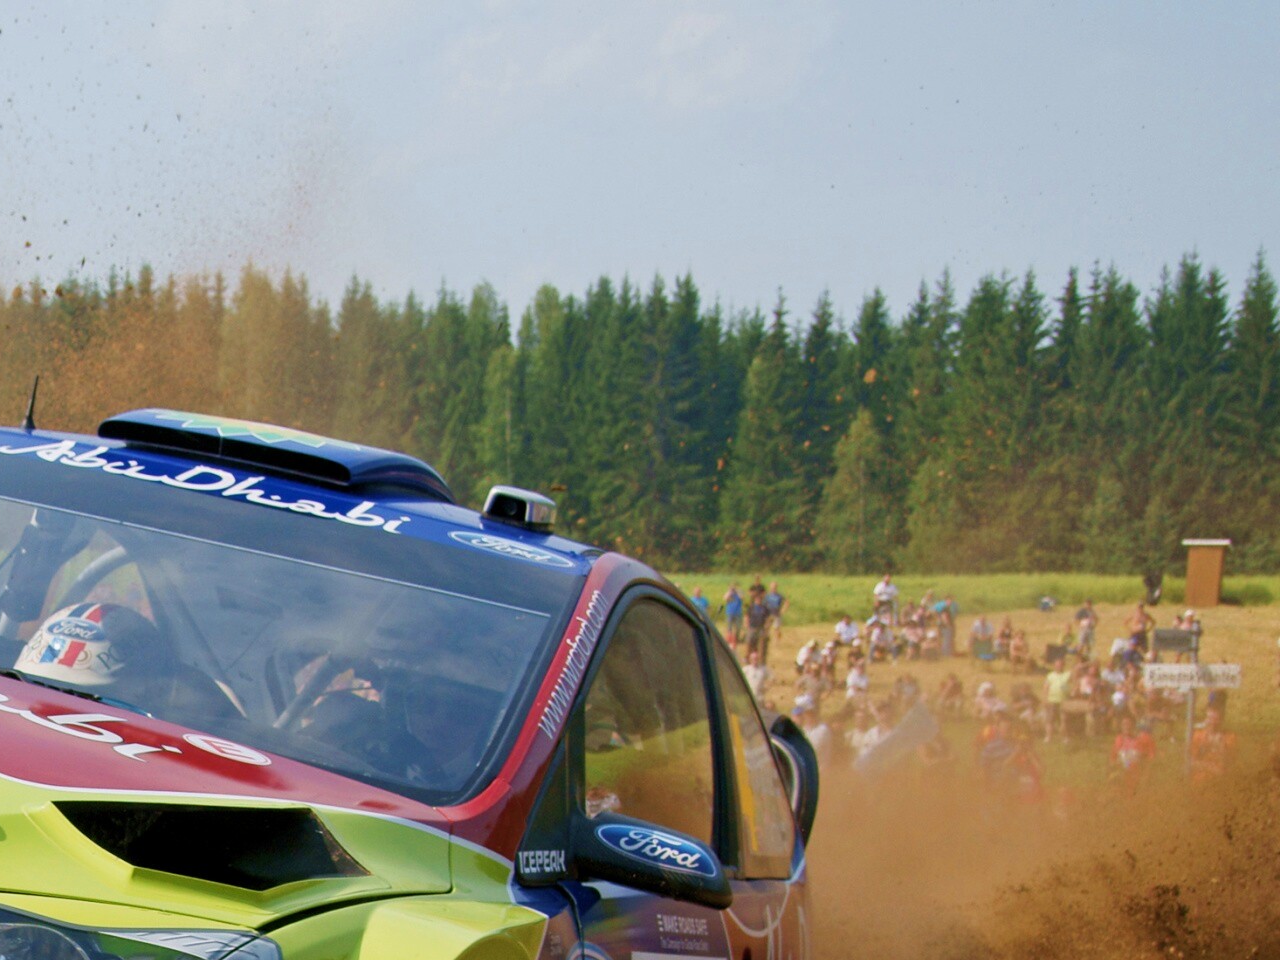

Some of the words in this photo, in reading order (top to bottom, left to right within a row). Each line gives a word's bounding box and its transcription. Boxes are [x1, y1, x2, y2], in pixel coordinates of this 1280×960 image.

[160, 465, 411, 534] Dhabi
[471, 536, 552, 562] Ford
[52, 620, 98, 640] Ford
[518, 849, 567, 874] ICEPEAK
[619, 829, 702, 868] Ford
